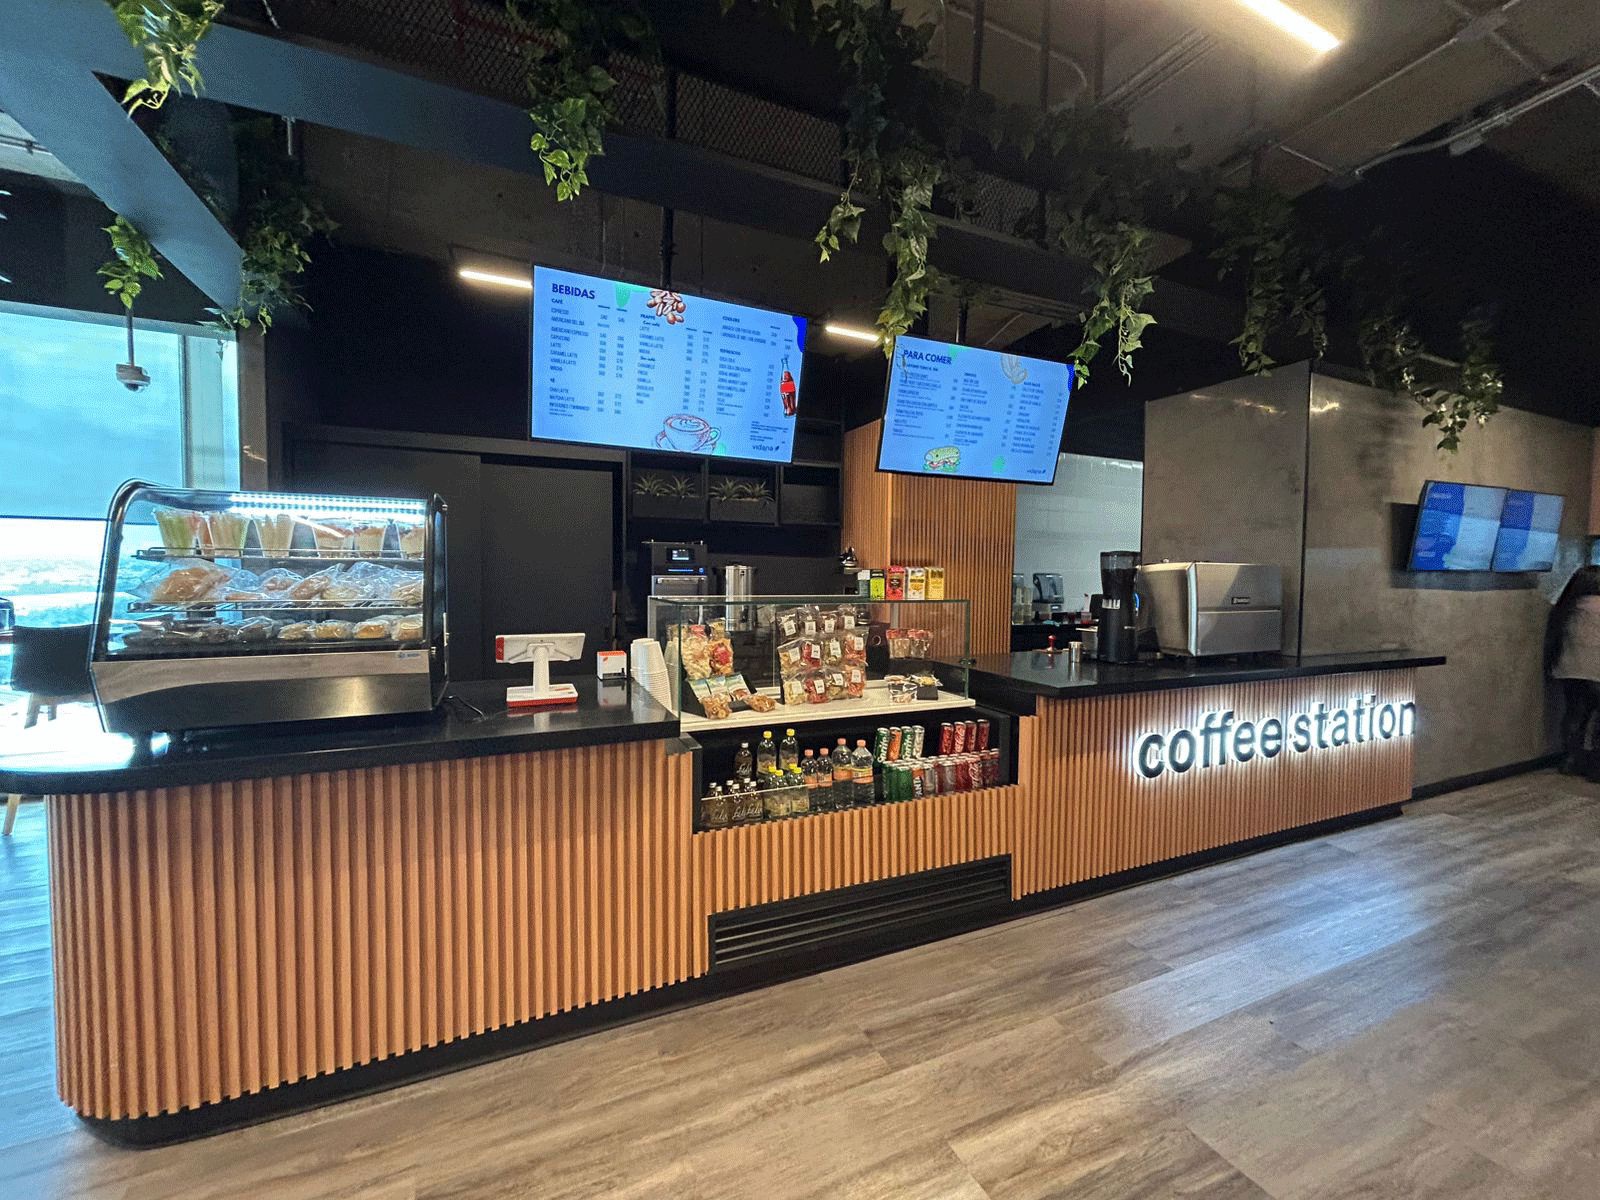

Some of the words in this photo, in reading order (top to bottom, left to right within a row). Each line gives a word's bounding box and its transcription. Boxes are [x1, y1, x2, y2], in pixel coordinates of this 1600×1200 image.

[552, 283, 596, 300] BEBIDAS
[904, 349, 923, 361] PARA
[925, 353, 952, 365] COMER
[1136, 709, 1283, 779] coffee
[1290, 694, 1417, 753] station
[877, 736, 889, 762] Sprite
